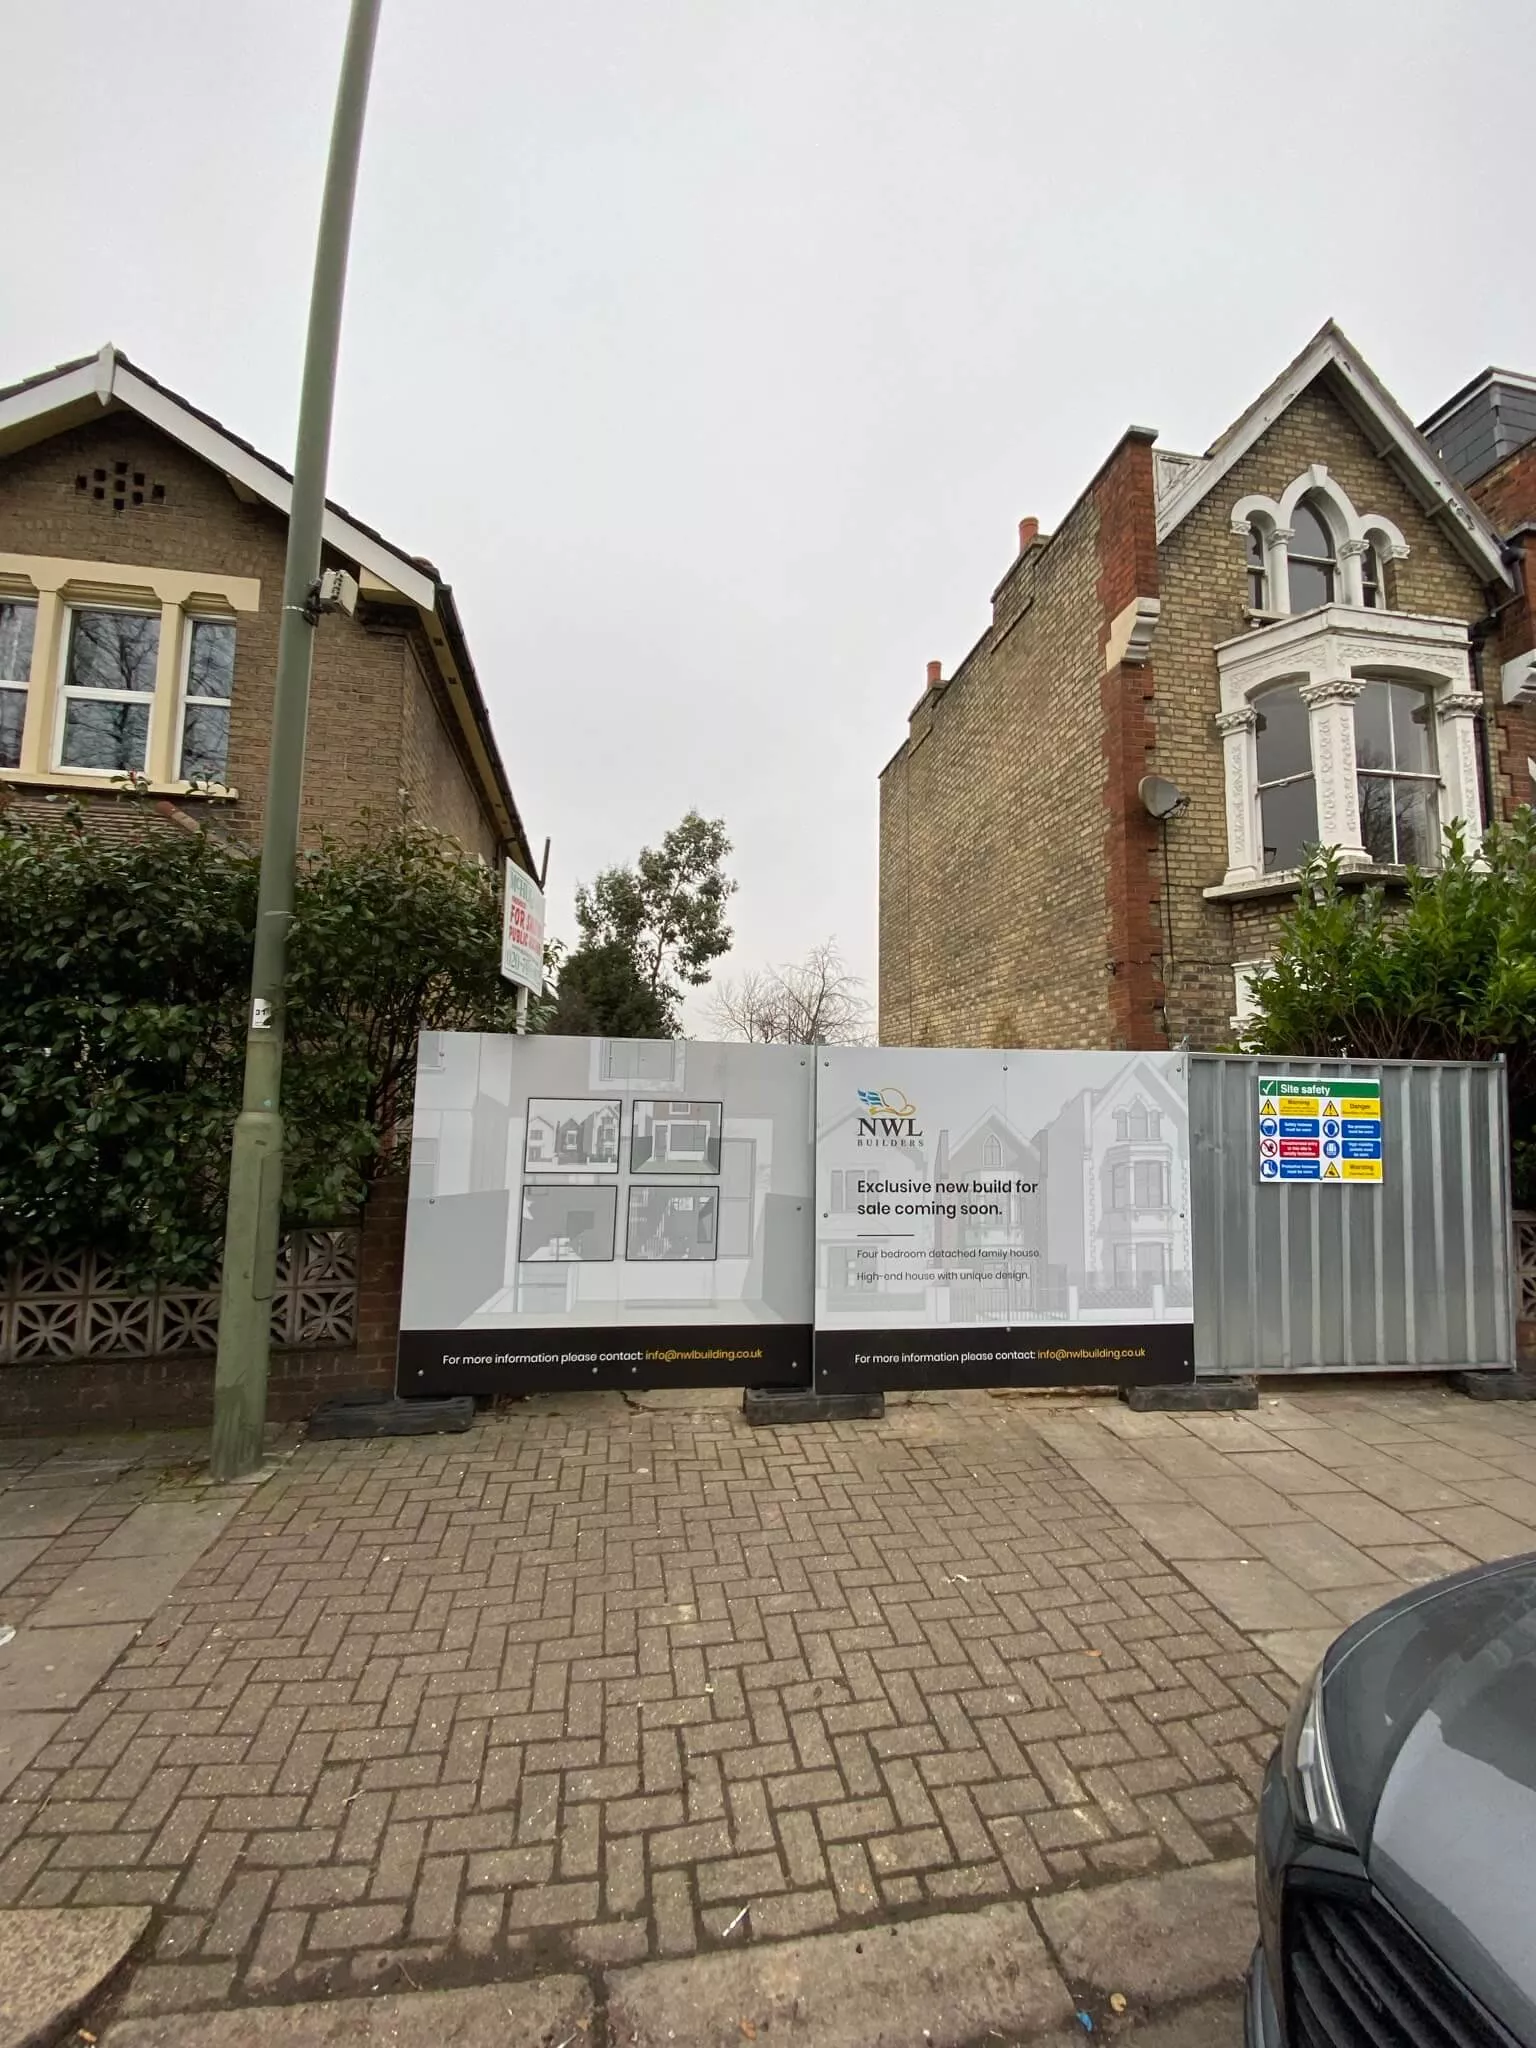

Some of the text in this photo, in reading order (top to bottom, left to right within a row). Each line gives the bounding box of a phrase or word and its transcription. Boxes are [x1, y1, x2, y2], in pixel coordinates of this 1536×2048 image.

[1280, 1084, 1331, 1096] Site safety
[856, 1118, 923, 1137] NWL
[857, 1138, 924, 1147] BUILDERS
[857, 1179, 1038, 1193] Exclusive new build for
[857, 1202, 1002, 1219] sale coming soon.
[857, 1249, 879, 1259] Four
[880, 1249, 927, 1258] bedroom
[928, 1248, 976, 1258] detached
[978, 1248, 1008, 1260] family
[857, 1271, 903, 1283] High-end
[905, 1271, 935, 1281] house
[937, 1271, 958, 1281] with
[959, 1271, 993, 1283] unique
[443, 1355, 460, 1365] For
[463, 1356, 492, 1364] more
[495, 1353, 559, 1364] information
[561, 1352, 597, 1365] please
[645, 1349, 763, 1362] info@nwlbuilding.co.uk
[855, 1354, 871, 1364] For
[872, 1355, 900, 1363] more
[901, 1352, 959, 1362] information
[961, 1351, 993, 1364] please
[1037, 1348, 1146, 1361] info@nwlbuilding.co.uk
